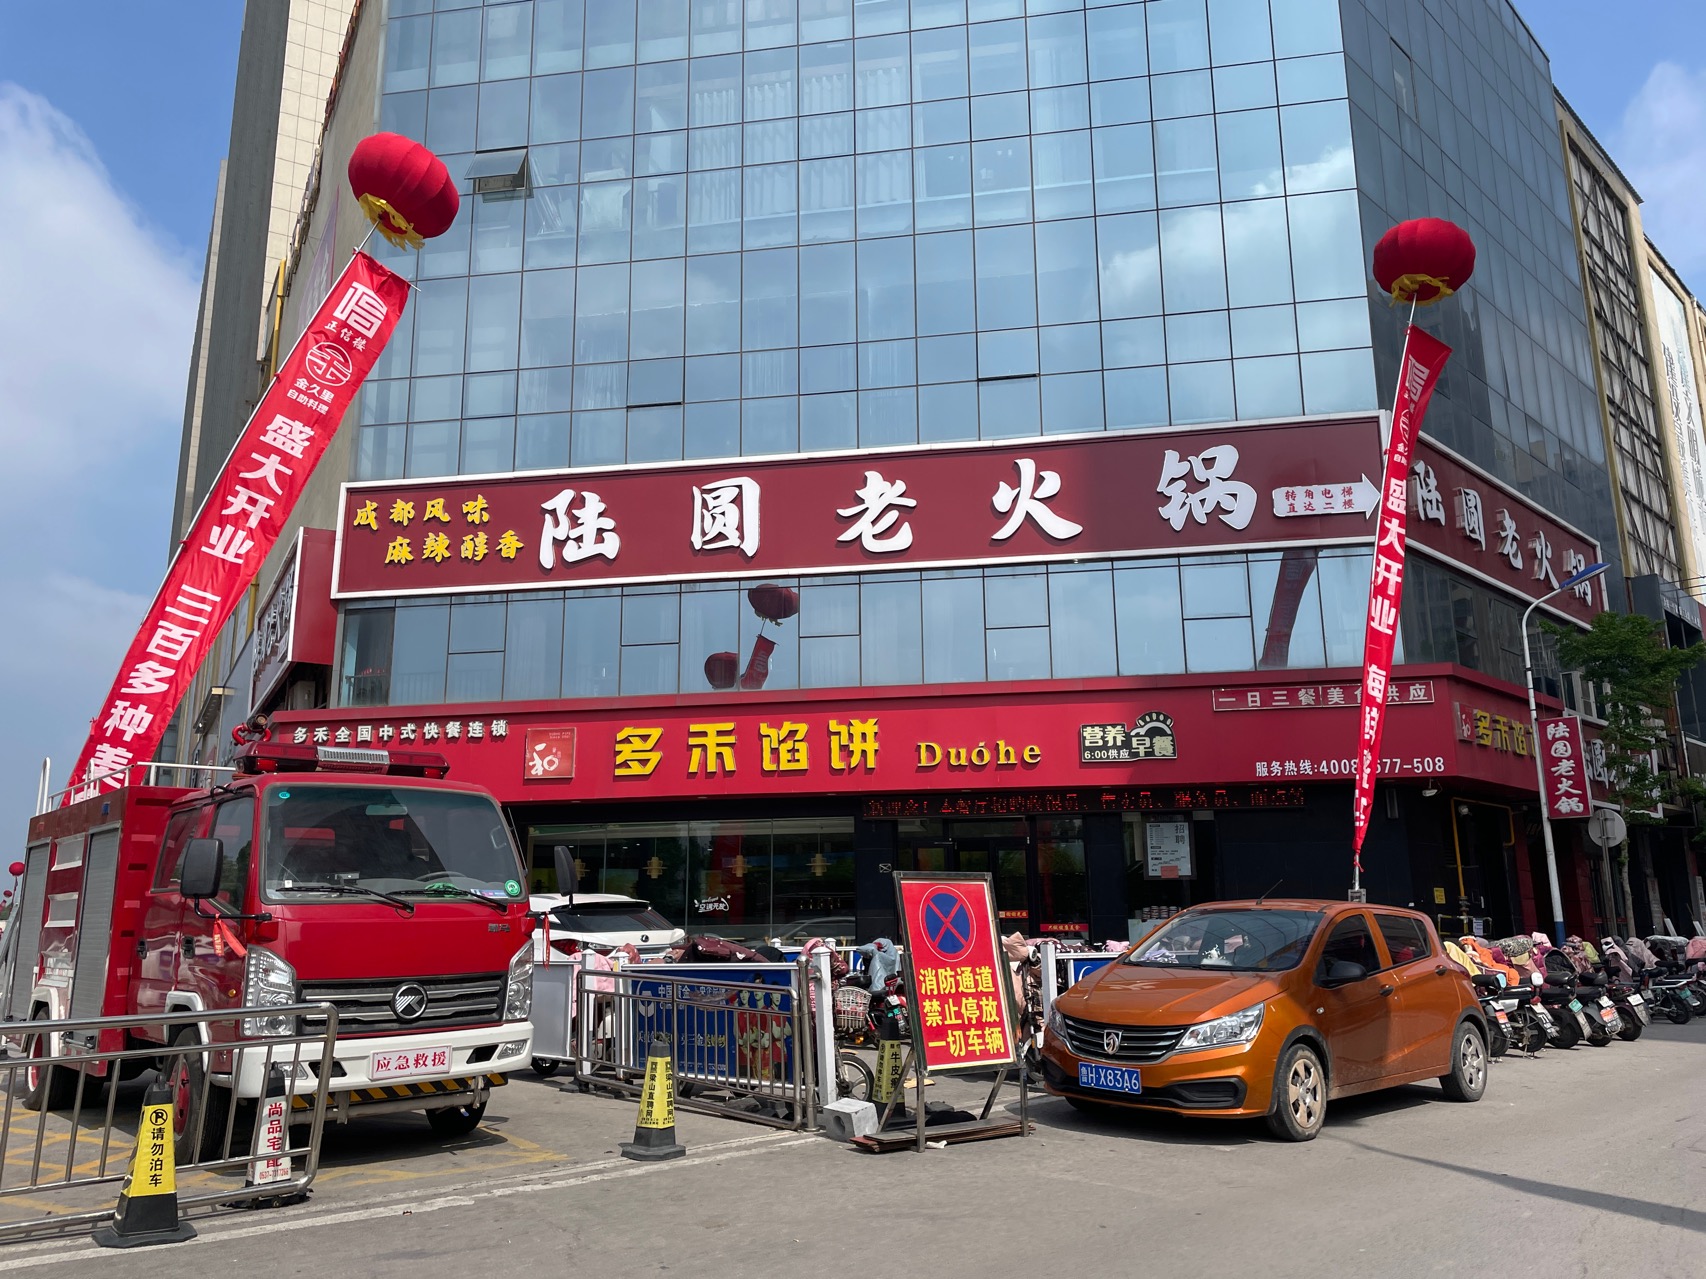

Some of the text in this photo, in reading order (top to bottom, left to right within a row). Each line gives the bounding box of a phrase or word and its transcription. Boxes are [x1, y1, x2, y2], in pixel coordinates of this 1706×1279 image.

[539, 444, 1258, 569] 陆圆老火锅
[1285, 486, 1353, 502] 转角电梯
[353, 493, 490, 530] 成都风味
[384, 529, 525, 565] 麻辣醇香
[74, 413, 315, 804] 盛大开业 三百多种美
[293, 719, 509, 744] 多禾全国中式快餐连锁
[1083, 725, 1126, 747] 营养
[1131, 736, 1175, 757] 早餐
[1475, 709, 1536, 758] 多禾馅
[614, 717, 880, 777] 多禾馅饼
[1084, 749, 1130, 759] 6:00供应
[918, 965, 995, 995] 消防通道
[922, 996, 1000, 1027] 禁止停放
[928, 1027, 1005, 1057] 一切车辆
[375, 1051, 447, 1073] 应急救援
[149, 1127, 165, 1187] 请勿泊车
